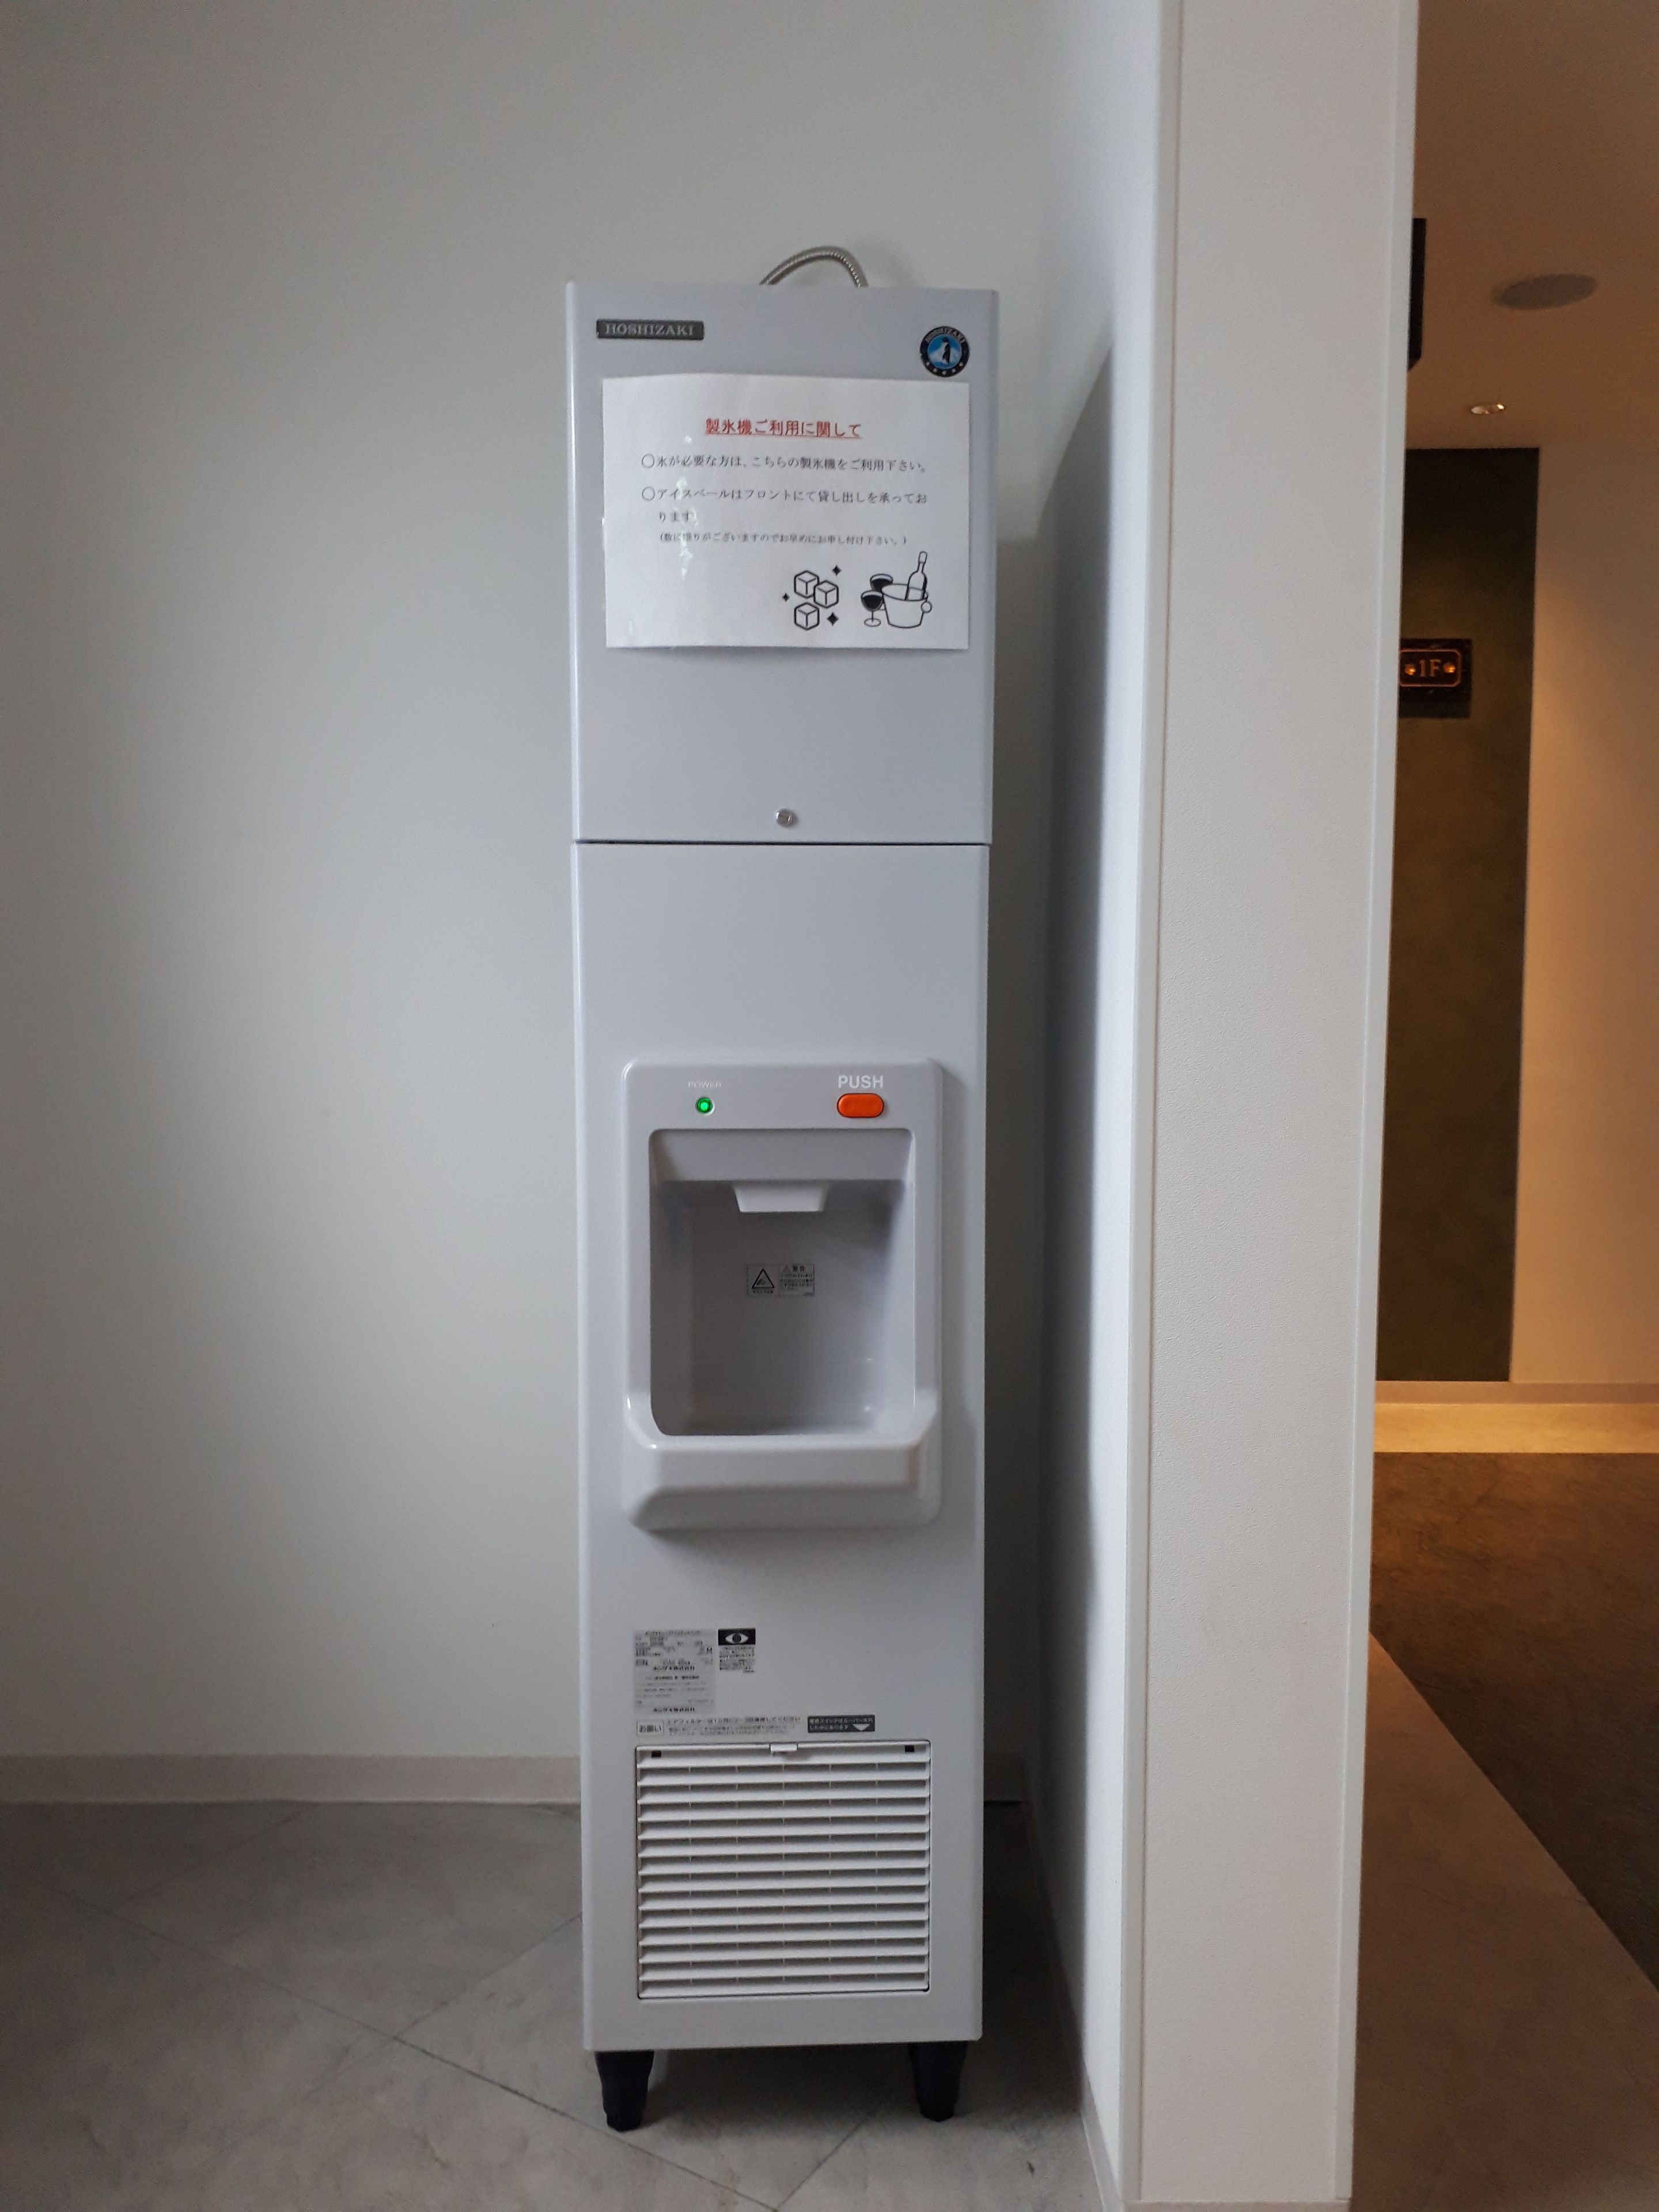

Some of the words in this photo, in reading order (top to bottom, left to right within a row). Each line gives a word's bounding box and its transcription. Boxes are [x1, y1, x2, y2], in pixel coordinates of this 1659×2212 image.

[605, 323, 695, 336] HOSHIZAKI
[925, 327, 966, 343] SHIZAKI
[706, 418, 862, 437] 製氷機ご利用に関して
[1419, 659, 1441, 677] 1F
[838, 1075, 884, 1088] PUSH
